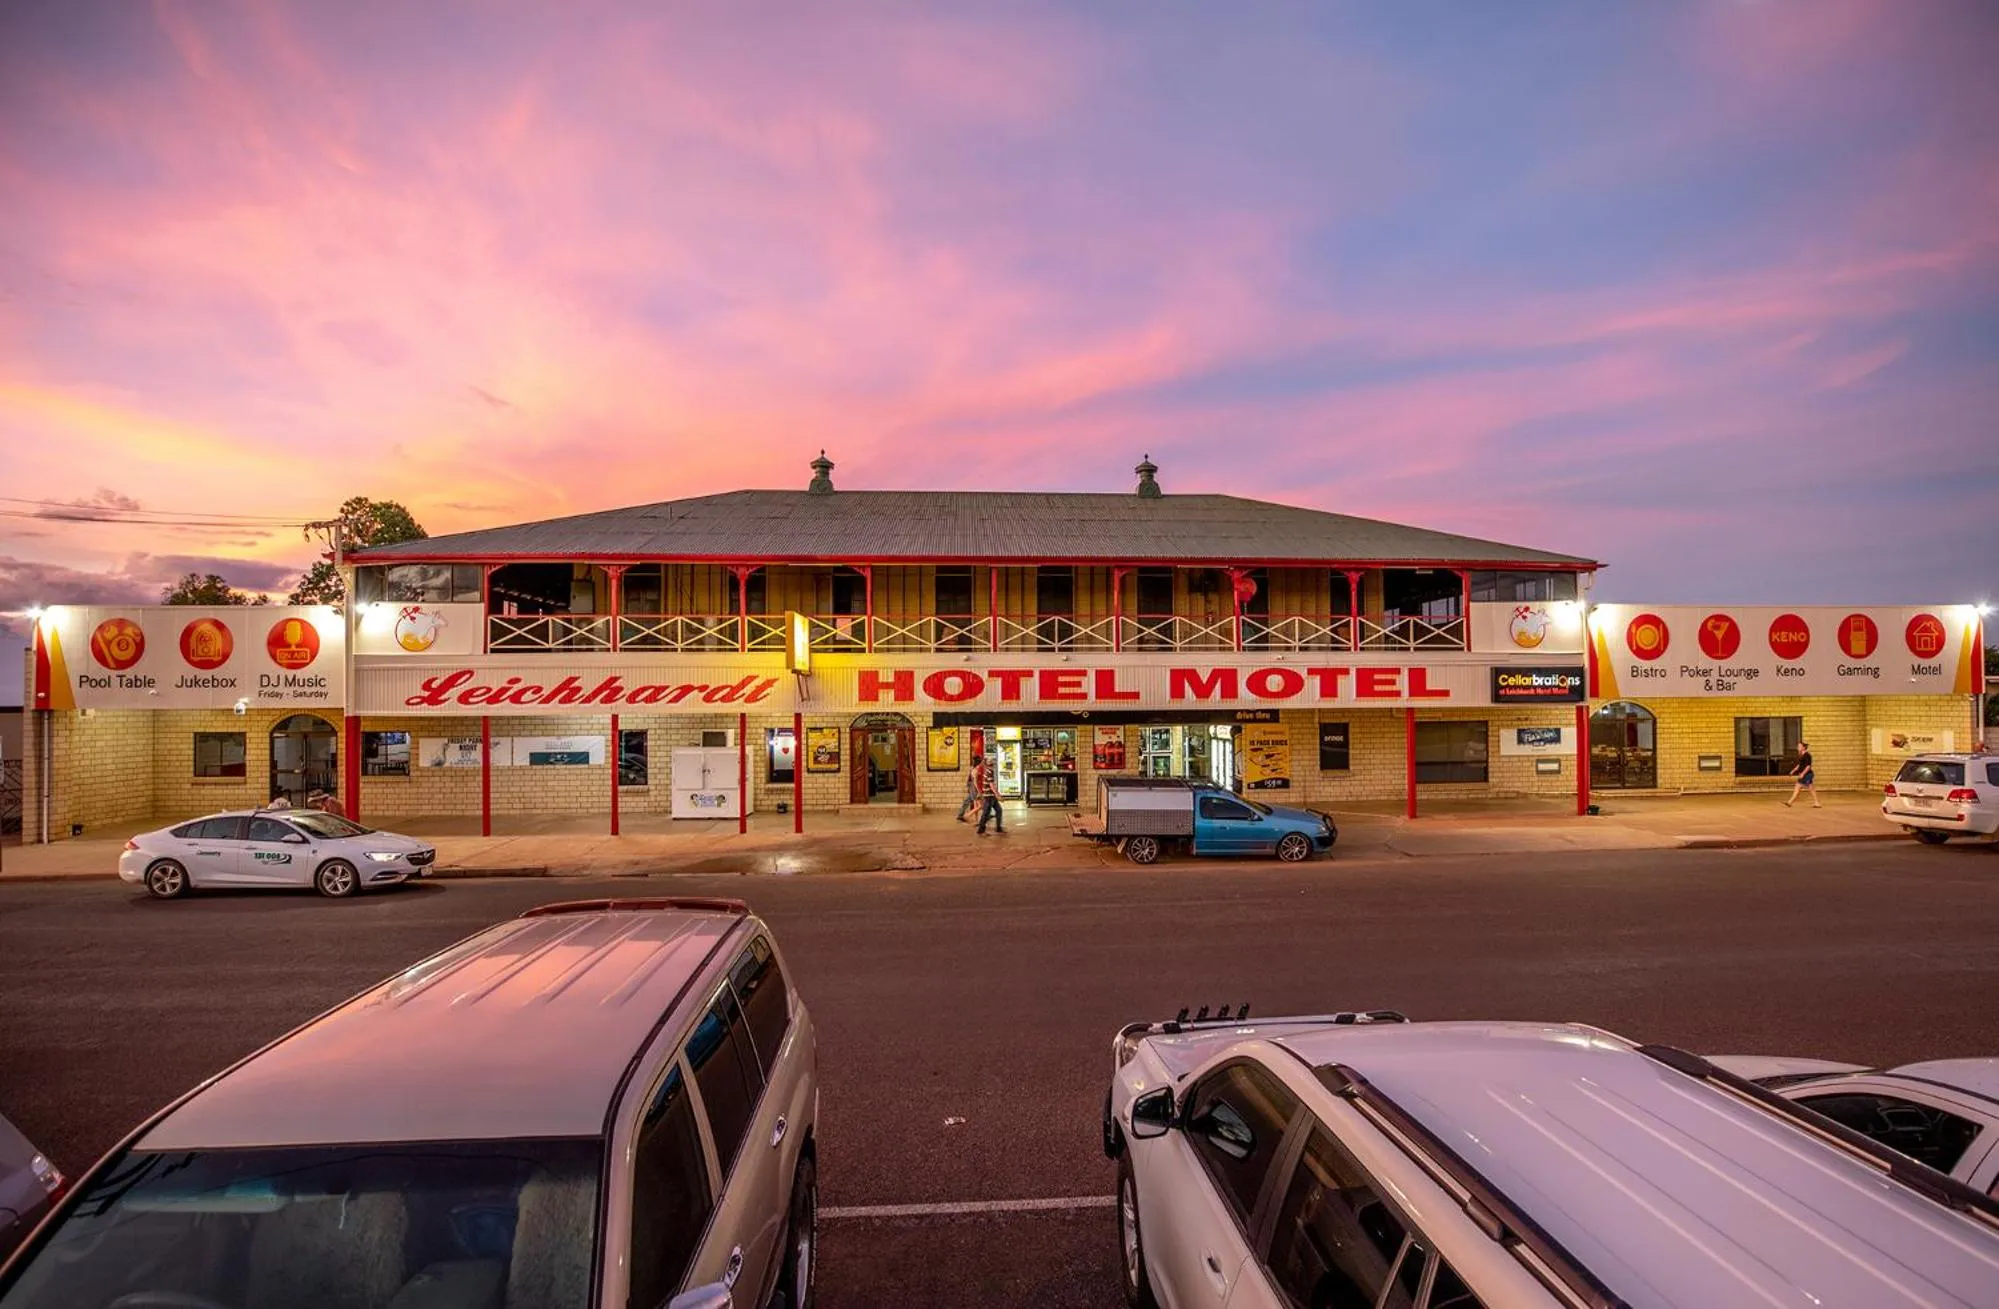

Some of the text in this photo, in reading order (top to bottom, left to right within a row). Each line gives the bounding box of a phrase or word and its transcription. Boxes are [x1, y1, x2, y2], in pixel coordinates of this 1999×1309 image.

[1772, 632, 1807, 642] KENO
[1630, 665, 1667, 678] Bistro
[1680, 665, 1760, 680] Poker Lounge
[1776, 665, 1805, 677] Keno
[1837, 665, 1880, 678] Gaming
[1911, 664, 1942, 676] Motel
[79, 674, 156, 688] Pool Table
[175, 675, 237, 688] Jukebox
[260, 674, 327, 687] DJ Music
[858, 668, 1450, 701] HOTEL MOTEL
[1499, 674, 1580, 687] Cellarbrations
[1704, 679, 1737, 691] & Bar
[405, 669, 780, 707] Leichhardt
[258, 690, 284, 700] Friday
[293, 690, 328, 699] Saturday
